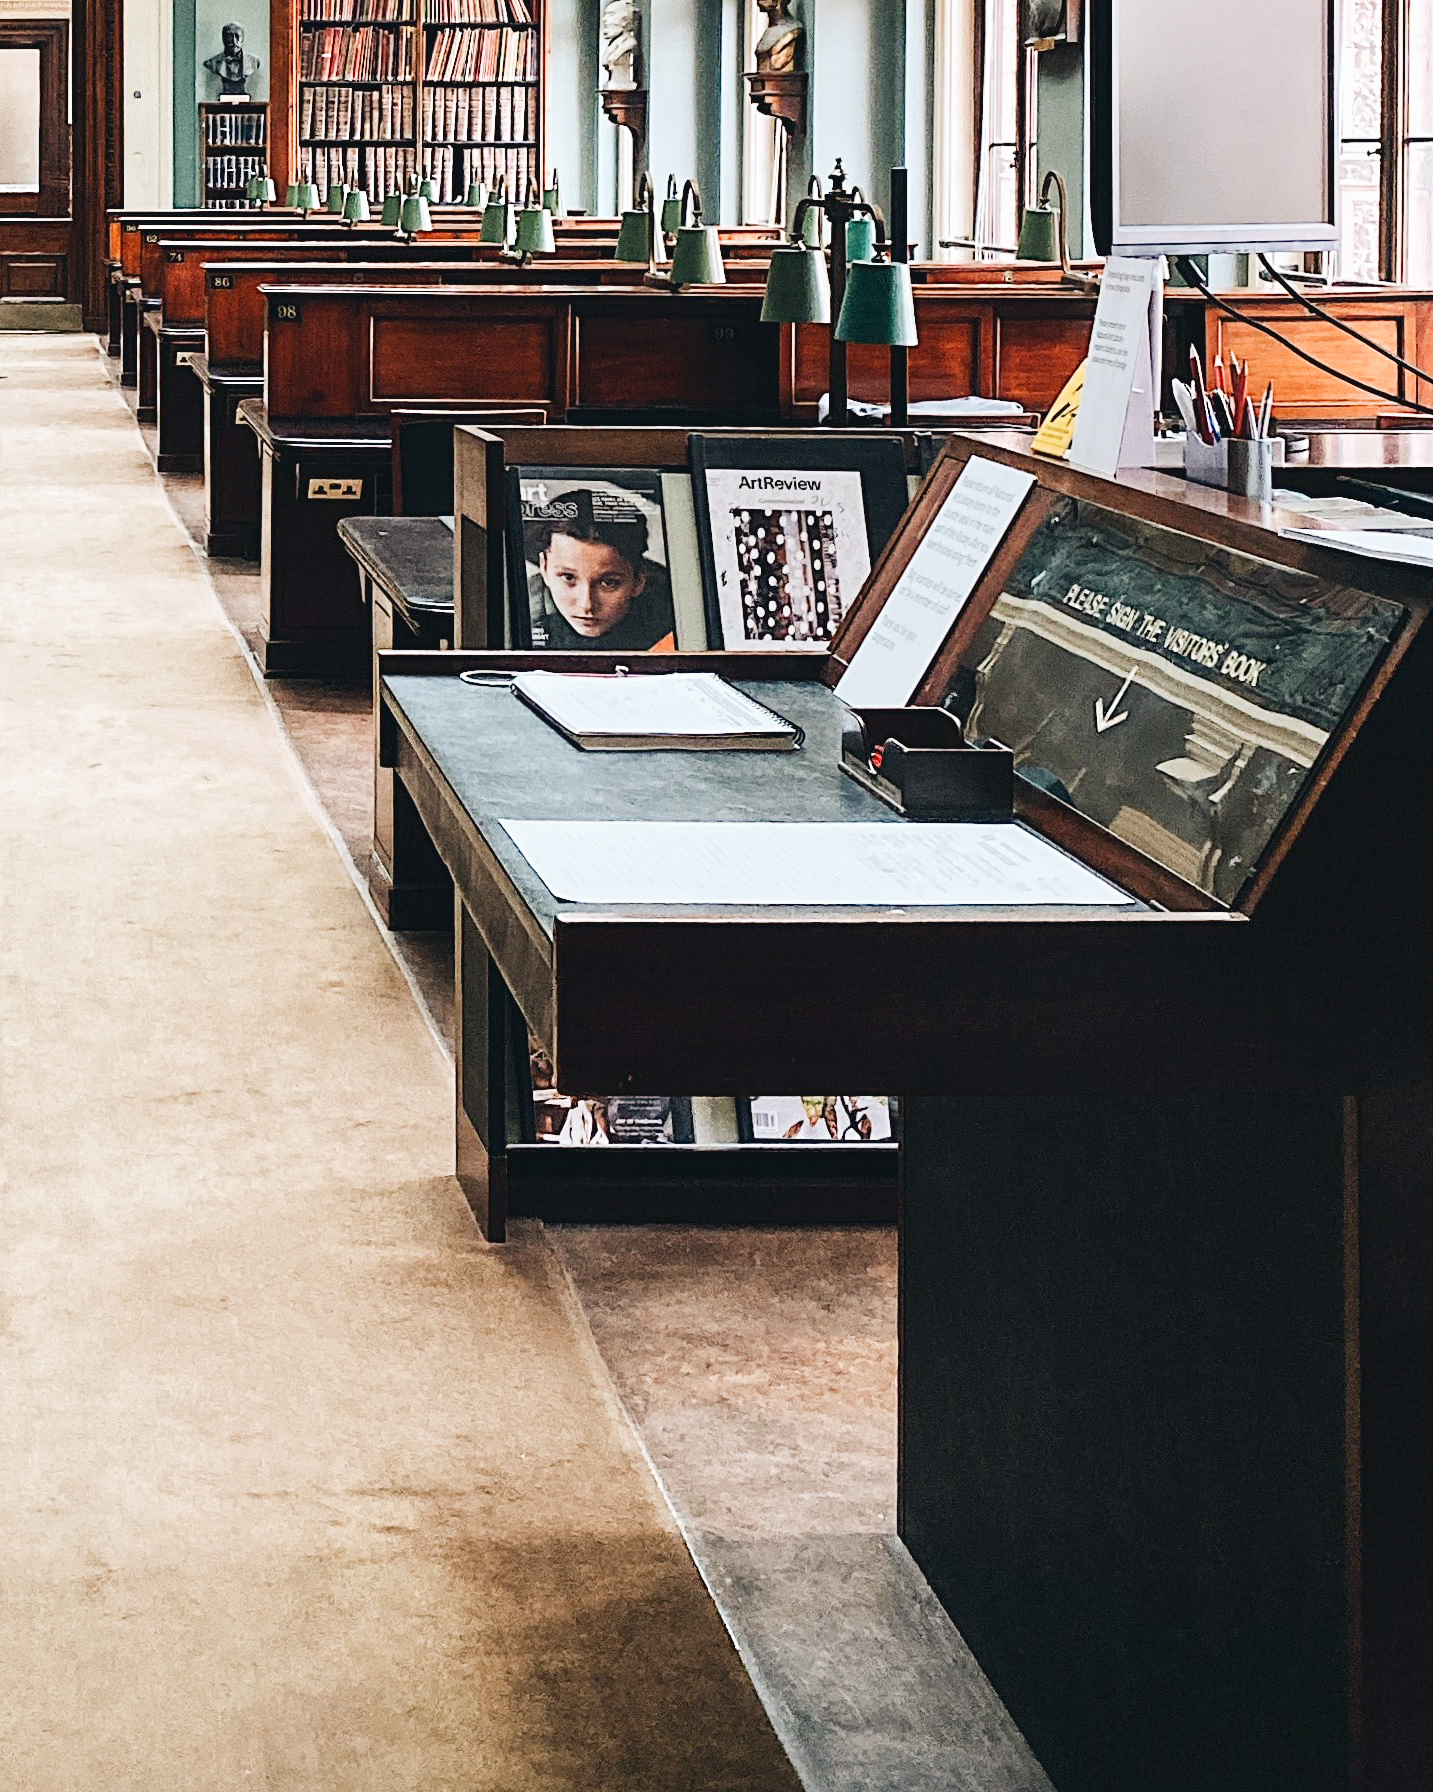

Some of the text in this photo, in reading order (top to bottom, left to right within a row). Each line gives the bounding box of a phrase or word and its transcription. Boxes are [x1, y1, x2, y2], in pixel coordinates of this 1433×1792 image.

[169, 252, 182, 262] 74
[277, 304, 297, 319] 98
[738, 476, 822, 490] ArtReview
[1063, 583, 1267, 687] PLEASE SIGN THE VISITORS' BOOK
